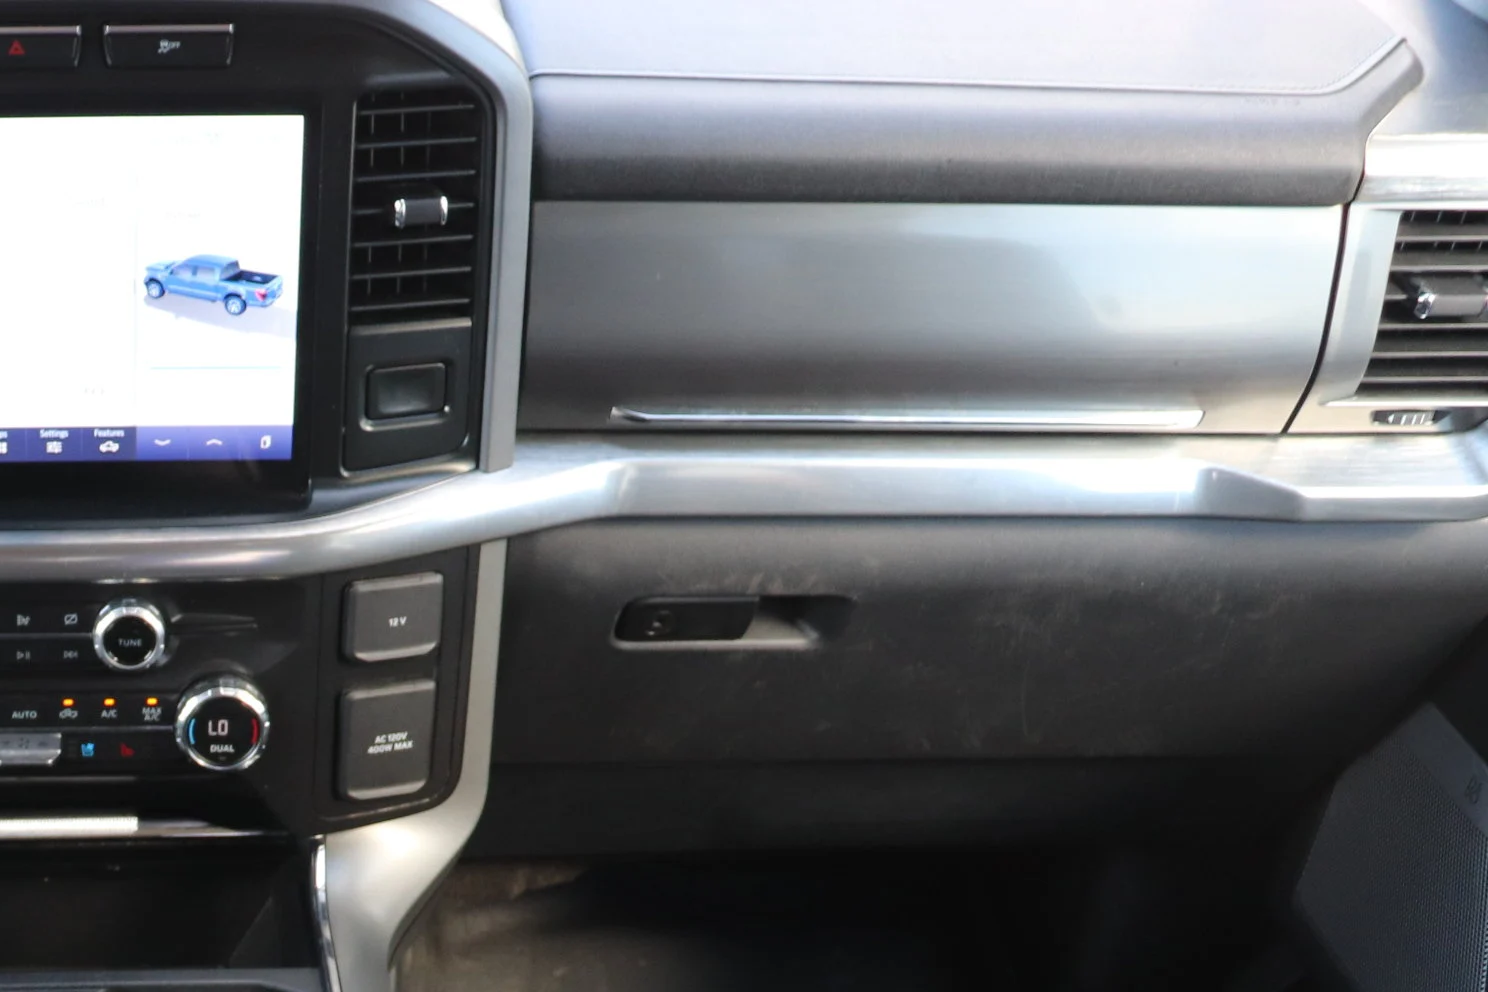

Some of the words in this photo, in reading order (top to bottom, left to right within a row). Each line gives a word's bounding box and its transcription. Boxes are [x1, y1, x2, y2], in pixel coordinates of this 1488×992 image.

[39, 428, 69, 440] Settings
[93, 428, 125, 438] Features
[118, 638, 142, 648] TUNE
[12, 710, 38, 720] AUTO
[101, 710, 118, 719] A/C
[142, 707, 162, 715] MAX
[144, 713, 161, 722] A/C
[374, 734, 386, 744] AC
[210, 744, 235, 754] DUAL
[394, 740, 414, 751] MAX
